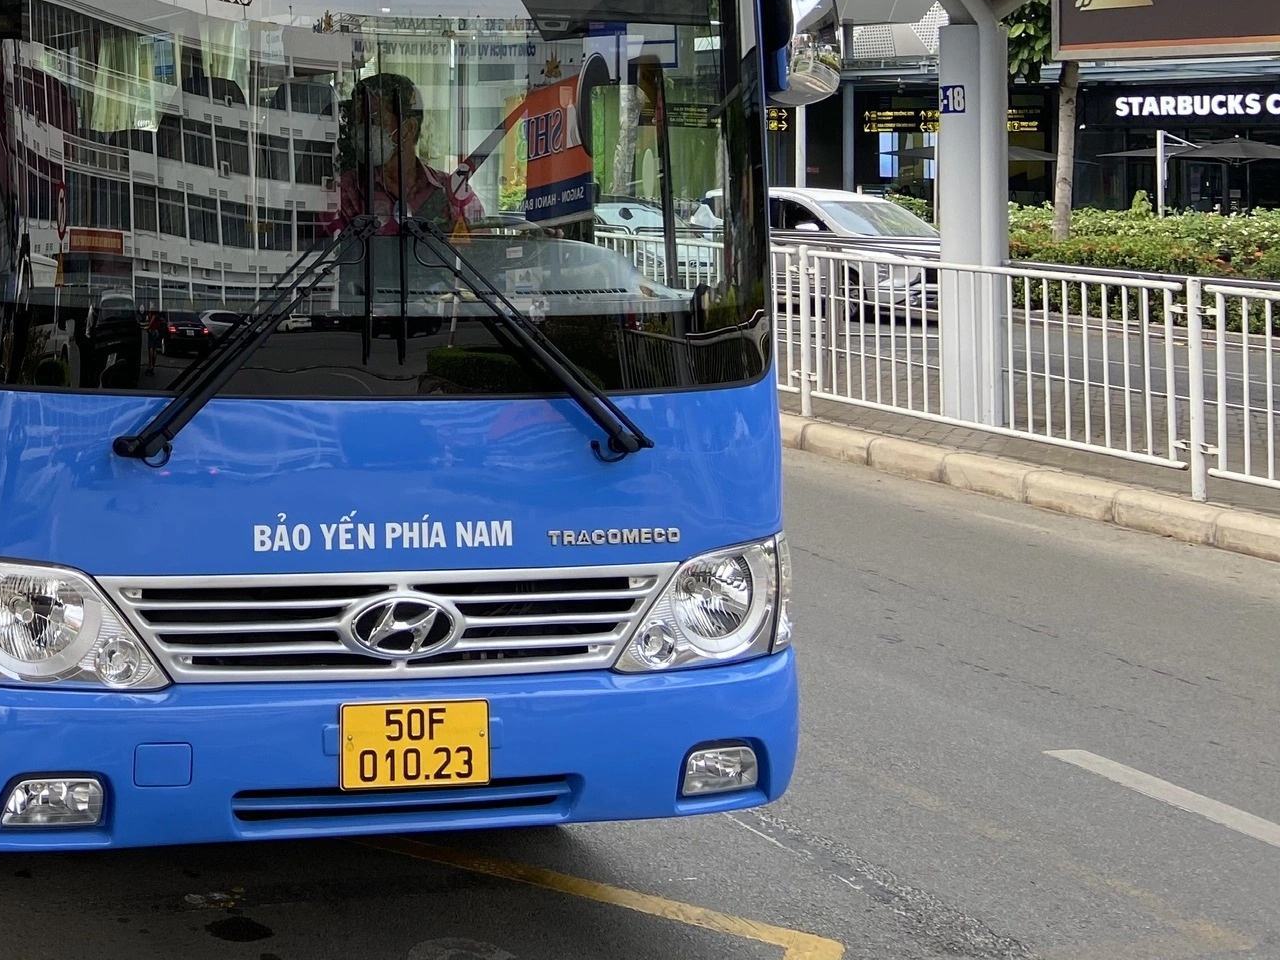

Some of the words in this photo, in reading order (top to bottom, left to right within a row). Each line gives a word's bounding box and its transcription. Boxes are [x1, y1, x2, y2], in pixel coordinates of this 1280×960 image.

[1115, 93, 1262, 116] STARBUCKS
[253, 512, 312, 552] BẢO
[319, 510, 375, 551] YẾN
[385, 514, 447, 549] PHÍA
[456, 520, 513, 548] NAM
[547, 527, 681, 546] TRACOMECO
[384, 707, 447, 742] 50F
[358, 745, 474, 784] 010.23
